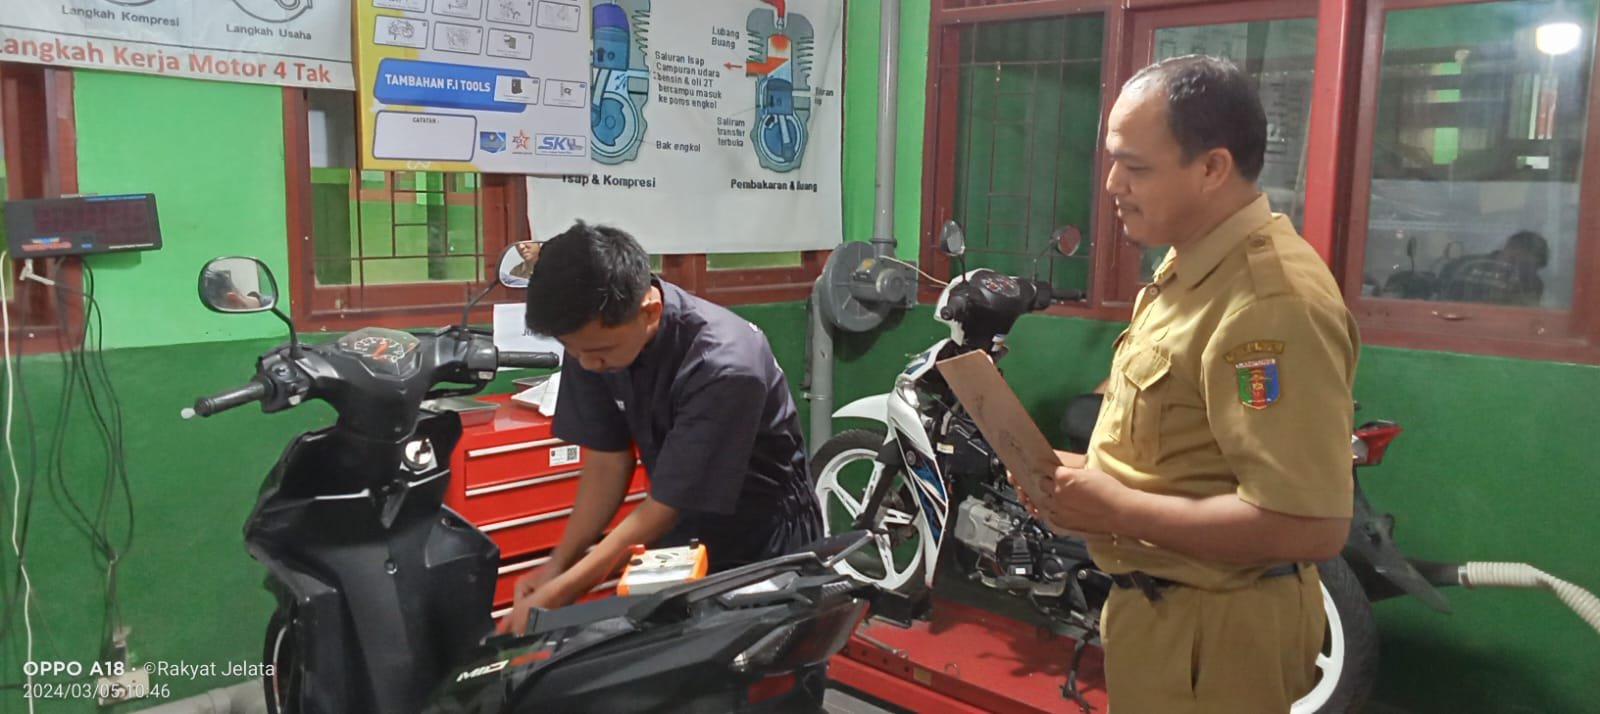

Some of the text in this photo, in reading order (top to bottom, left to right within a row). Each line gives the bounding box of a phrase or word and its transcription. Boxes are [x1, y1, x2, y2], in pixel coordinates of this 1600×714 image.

[61, 5, 180, 27] Langkah Kompresi
[226, 23, 312, 40] Langkah Usaha
[711, 26, 740, 40] Lubang
[711, 37, 736, 50] Buang
[0, 37, 331, 83] angkah Kerja Motor 4 Tak
[656, 62, 720, 78] Campuran udara
[384, 73, 445, 89] TAMBAHAN
[460, 80, 491, 93] TOOLS
[696, 90, 722, 99] masuk
[656, 140, 701, 153] Bak engkol
[591, 176, 600, 186] &
[603, 175, 656, 189] Kompresi
[730, 179, 788, 191] Pembakaran
